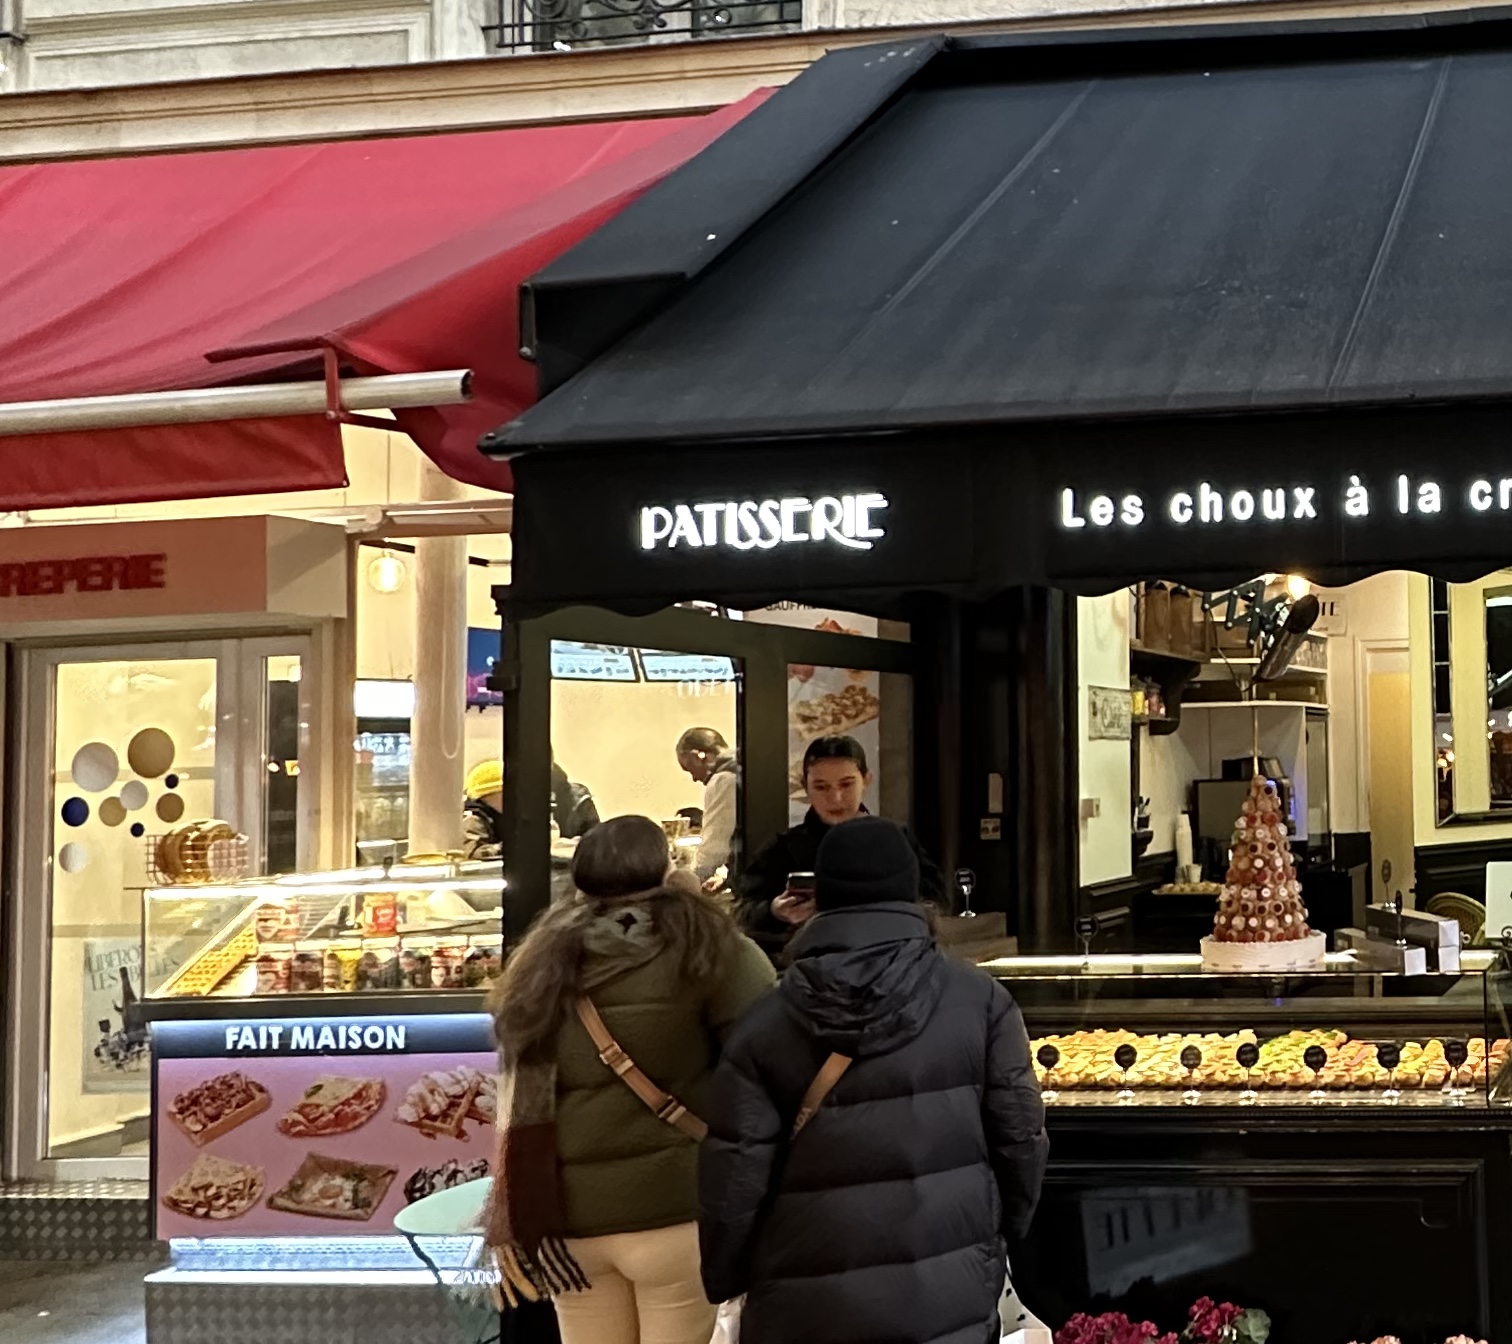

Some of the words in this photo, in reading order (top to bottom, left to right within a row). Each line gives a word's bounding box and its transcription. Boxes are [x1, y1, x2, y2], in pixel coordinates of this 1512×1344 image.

[640, 492, 889, 550] PATISSERIE
[1061, 487, 1145, 528] Les
[1169, 482, 1318, 524] choux
[1344, 475, 1370, 517] à
[1397, 474, 1442, 514] la
[225, 1025, 284, 1050] FAIT
[290, 1024, 406, 1050] MAISON
